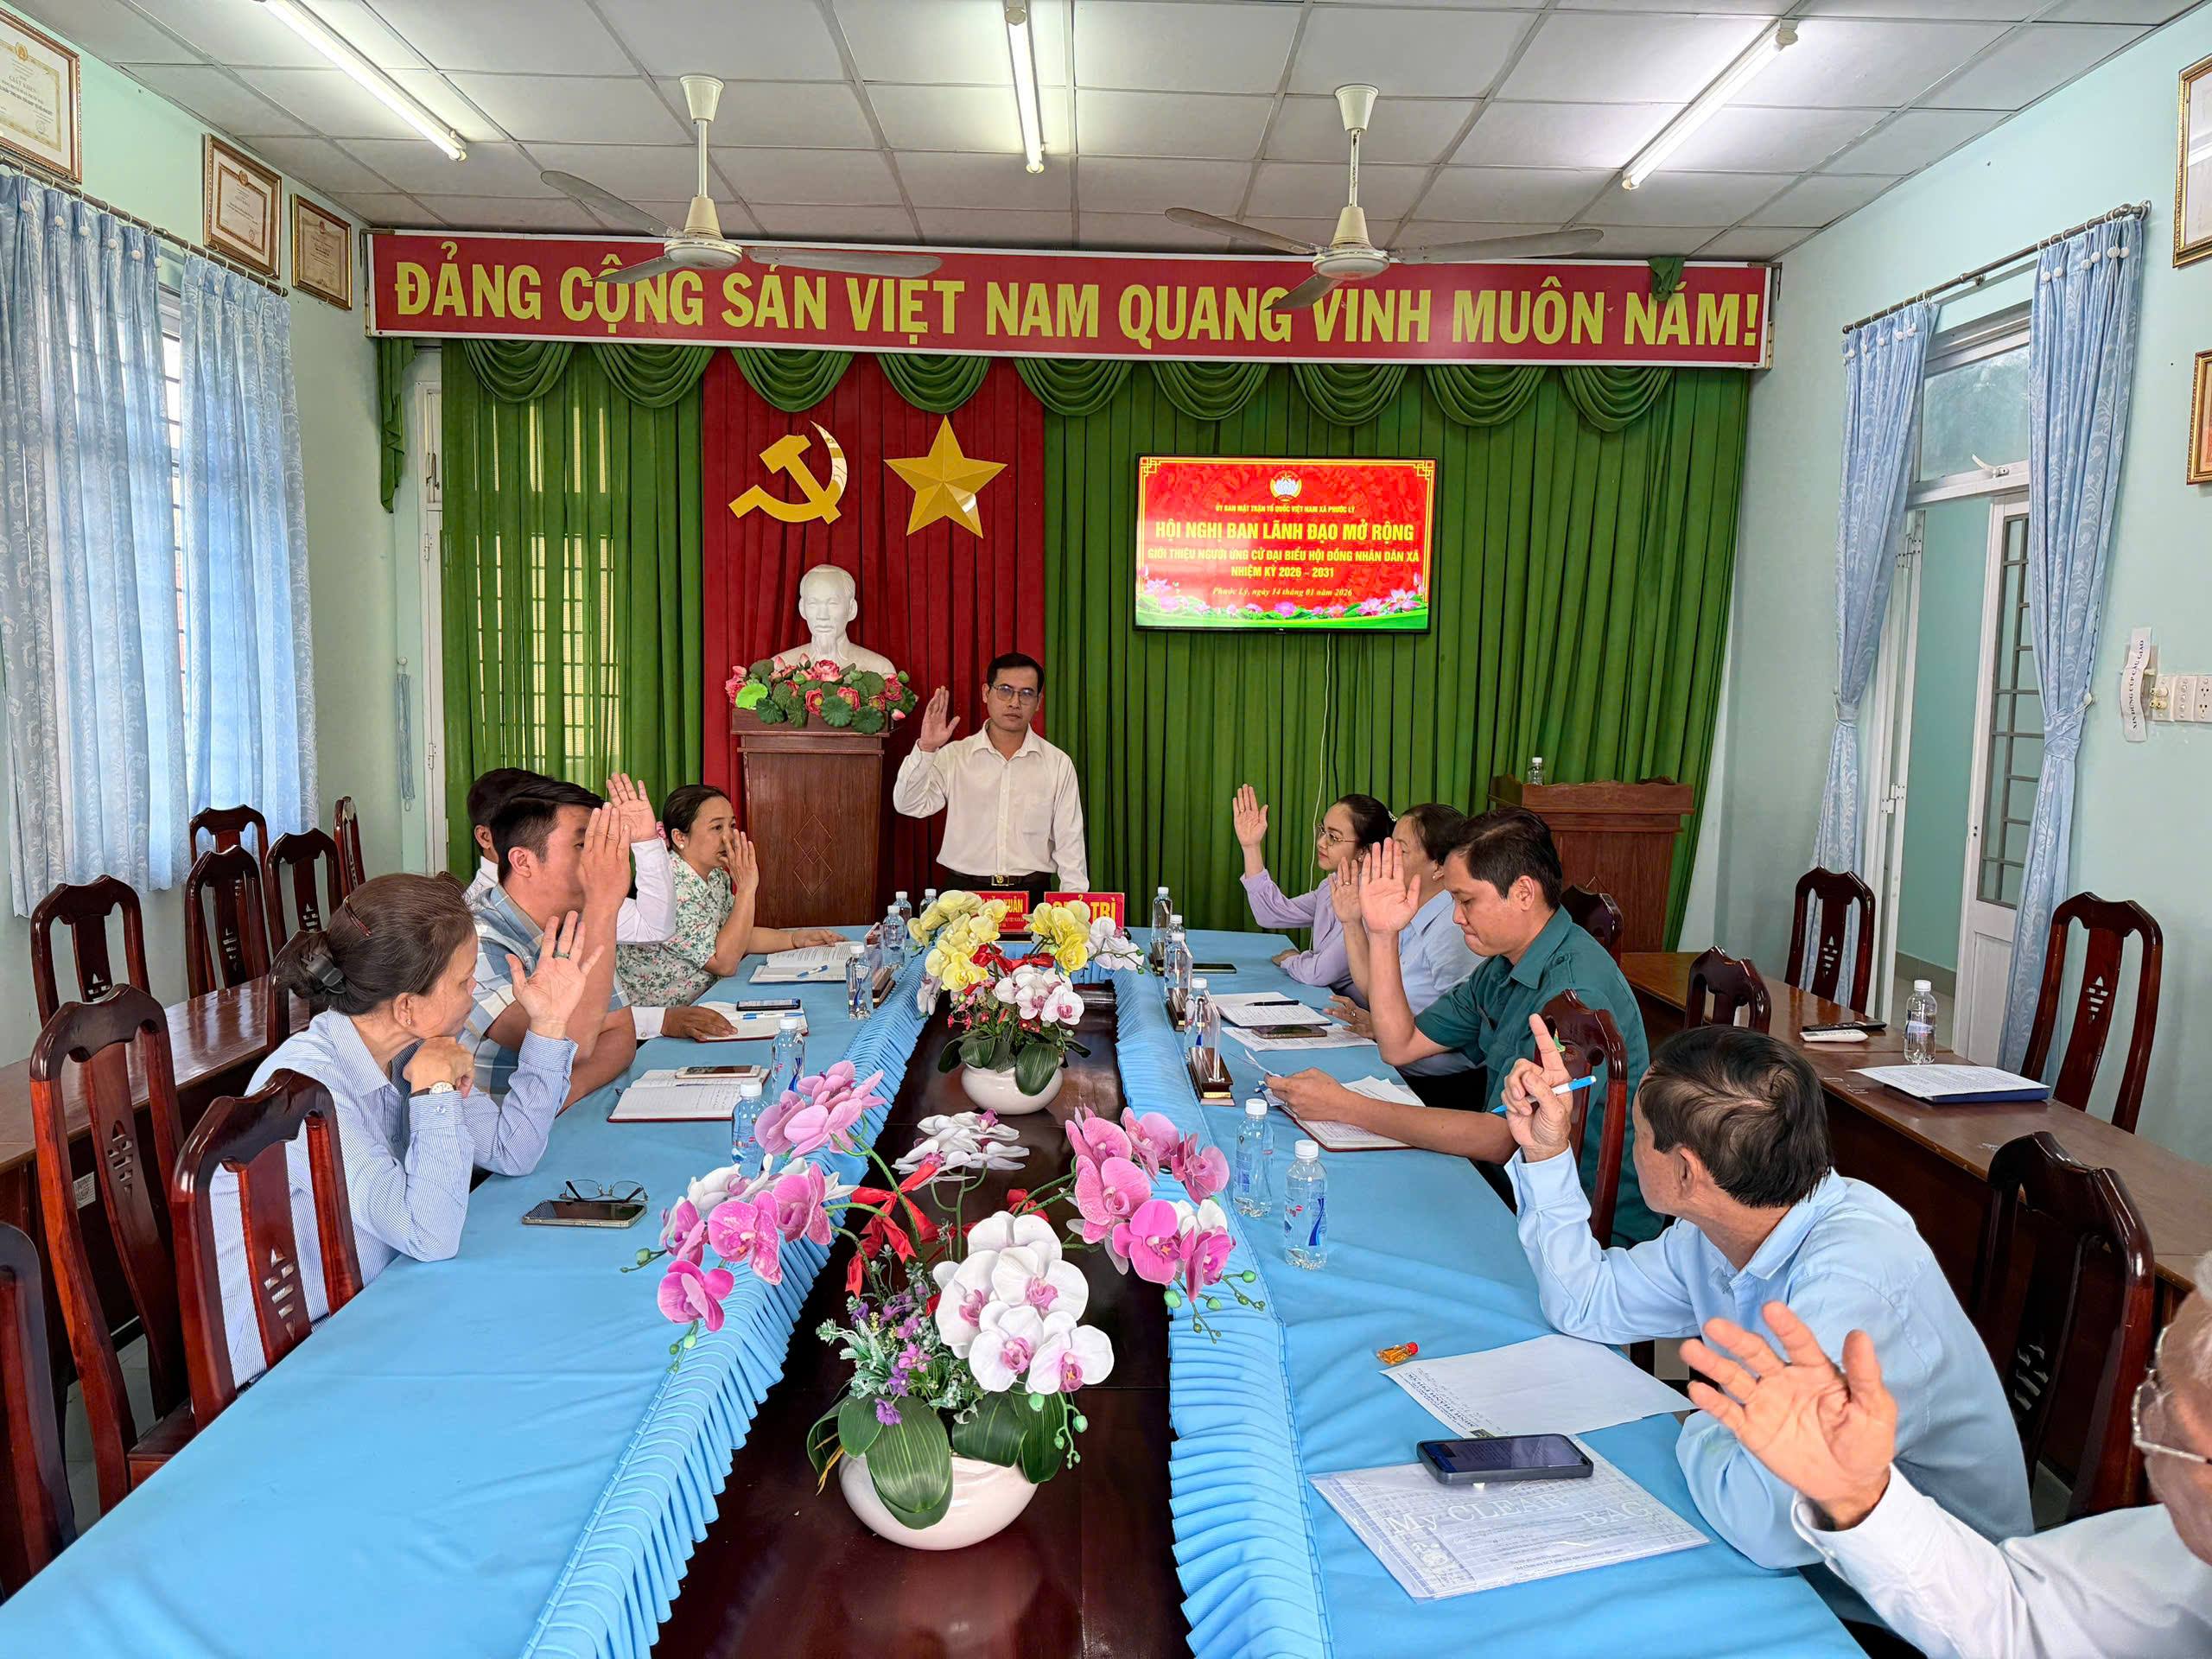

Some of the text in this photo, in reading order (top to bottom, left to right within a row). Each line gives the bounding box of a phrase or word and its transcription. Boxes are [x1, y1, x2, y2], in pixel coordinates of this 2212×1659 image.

[394, 241, 541, 321] ĐẢNG
[560, 253, 703, 334] CỘNG
[986, 282, 1099, 338] NAM
[1119, 284, 1293, 350] QUANG
[1313, 289, 1431, 343] VINH
[1452, 276, 1605, 345] MUÔN
[1155, 518, 1414, 544] HỘI NGHỊ BAN LÃNH ĐẠO MỞ RỘNG
[1147, 545, 1166, 559] GIỚI
[1169, 547, 1196, 561] THIỆU
[1198, 547, 1227, 560] NGƯỜI
[1251, 547, 1265, 560] CỬ
[1266, 549, 1282, 563] ĐẠI
[1285, 546, 1306, 561] BIỂU
[1308, 548, 1325, 563] HỘI
[1355, 549, 1382, 562] NHÂN
[1384, 549, 1404, 562] DÂN
[1230, 563, 1262, 579] NHIỆM
[1264, 563, 1276, 577] KỲ
[1279, 566, 1302, 577] 2026
[1312, 567, 1334, 578] 2031
[1251, 588, 1270, 597] ngày
[1281, 588, 1304, 597] tháng
[1090, 897, 1116, 922] TRÌ
[1383, 1491, 1570, 1535] My CLEAR
[1581, 1501, 1650, 1526] BAG
